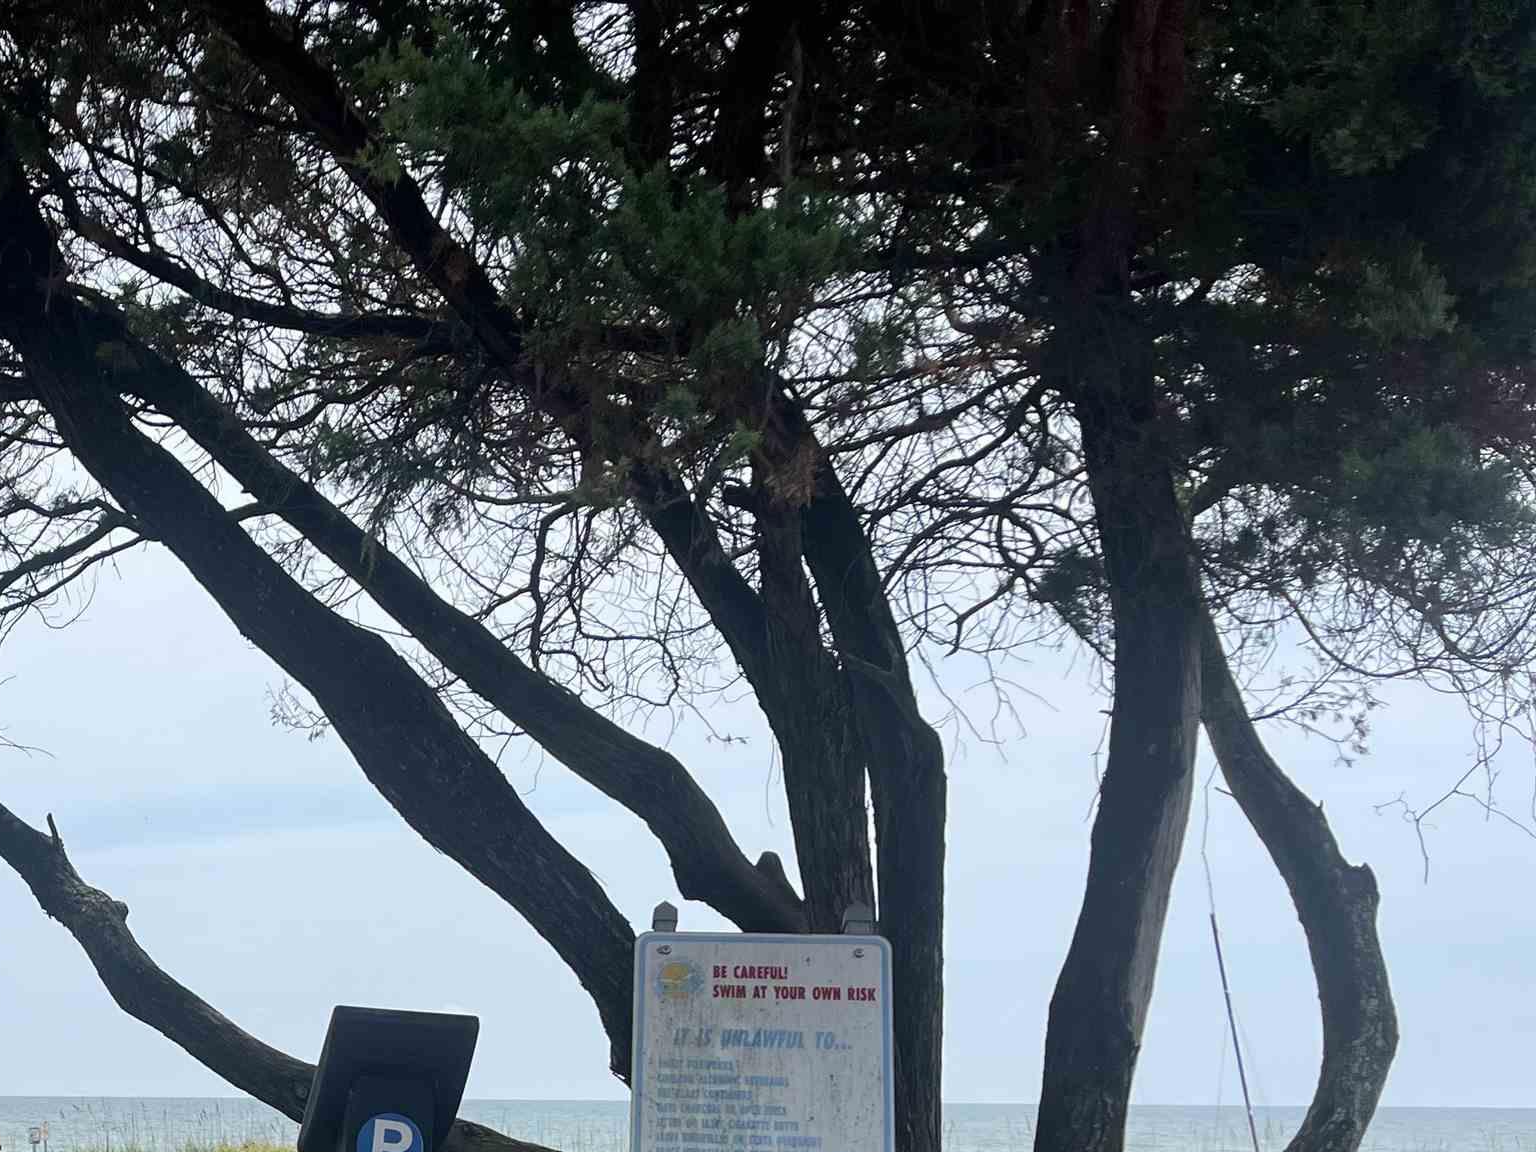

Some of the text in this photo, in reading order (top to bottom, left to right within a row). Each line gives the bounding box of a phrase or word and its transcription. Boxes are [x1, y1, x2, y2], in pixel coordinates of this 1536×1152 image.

[713, 966, 788, 980] BE CAREFUL!
[713, 985, 876, 1001] SWIM AT YOUR OWN RISK
[719, 1028, 805, 1050] UNLAWFUL
